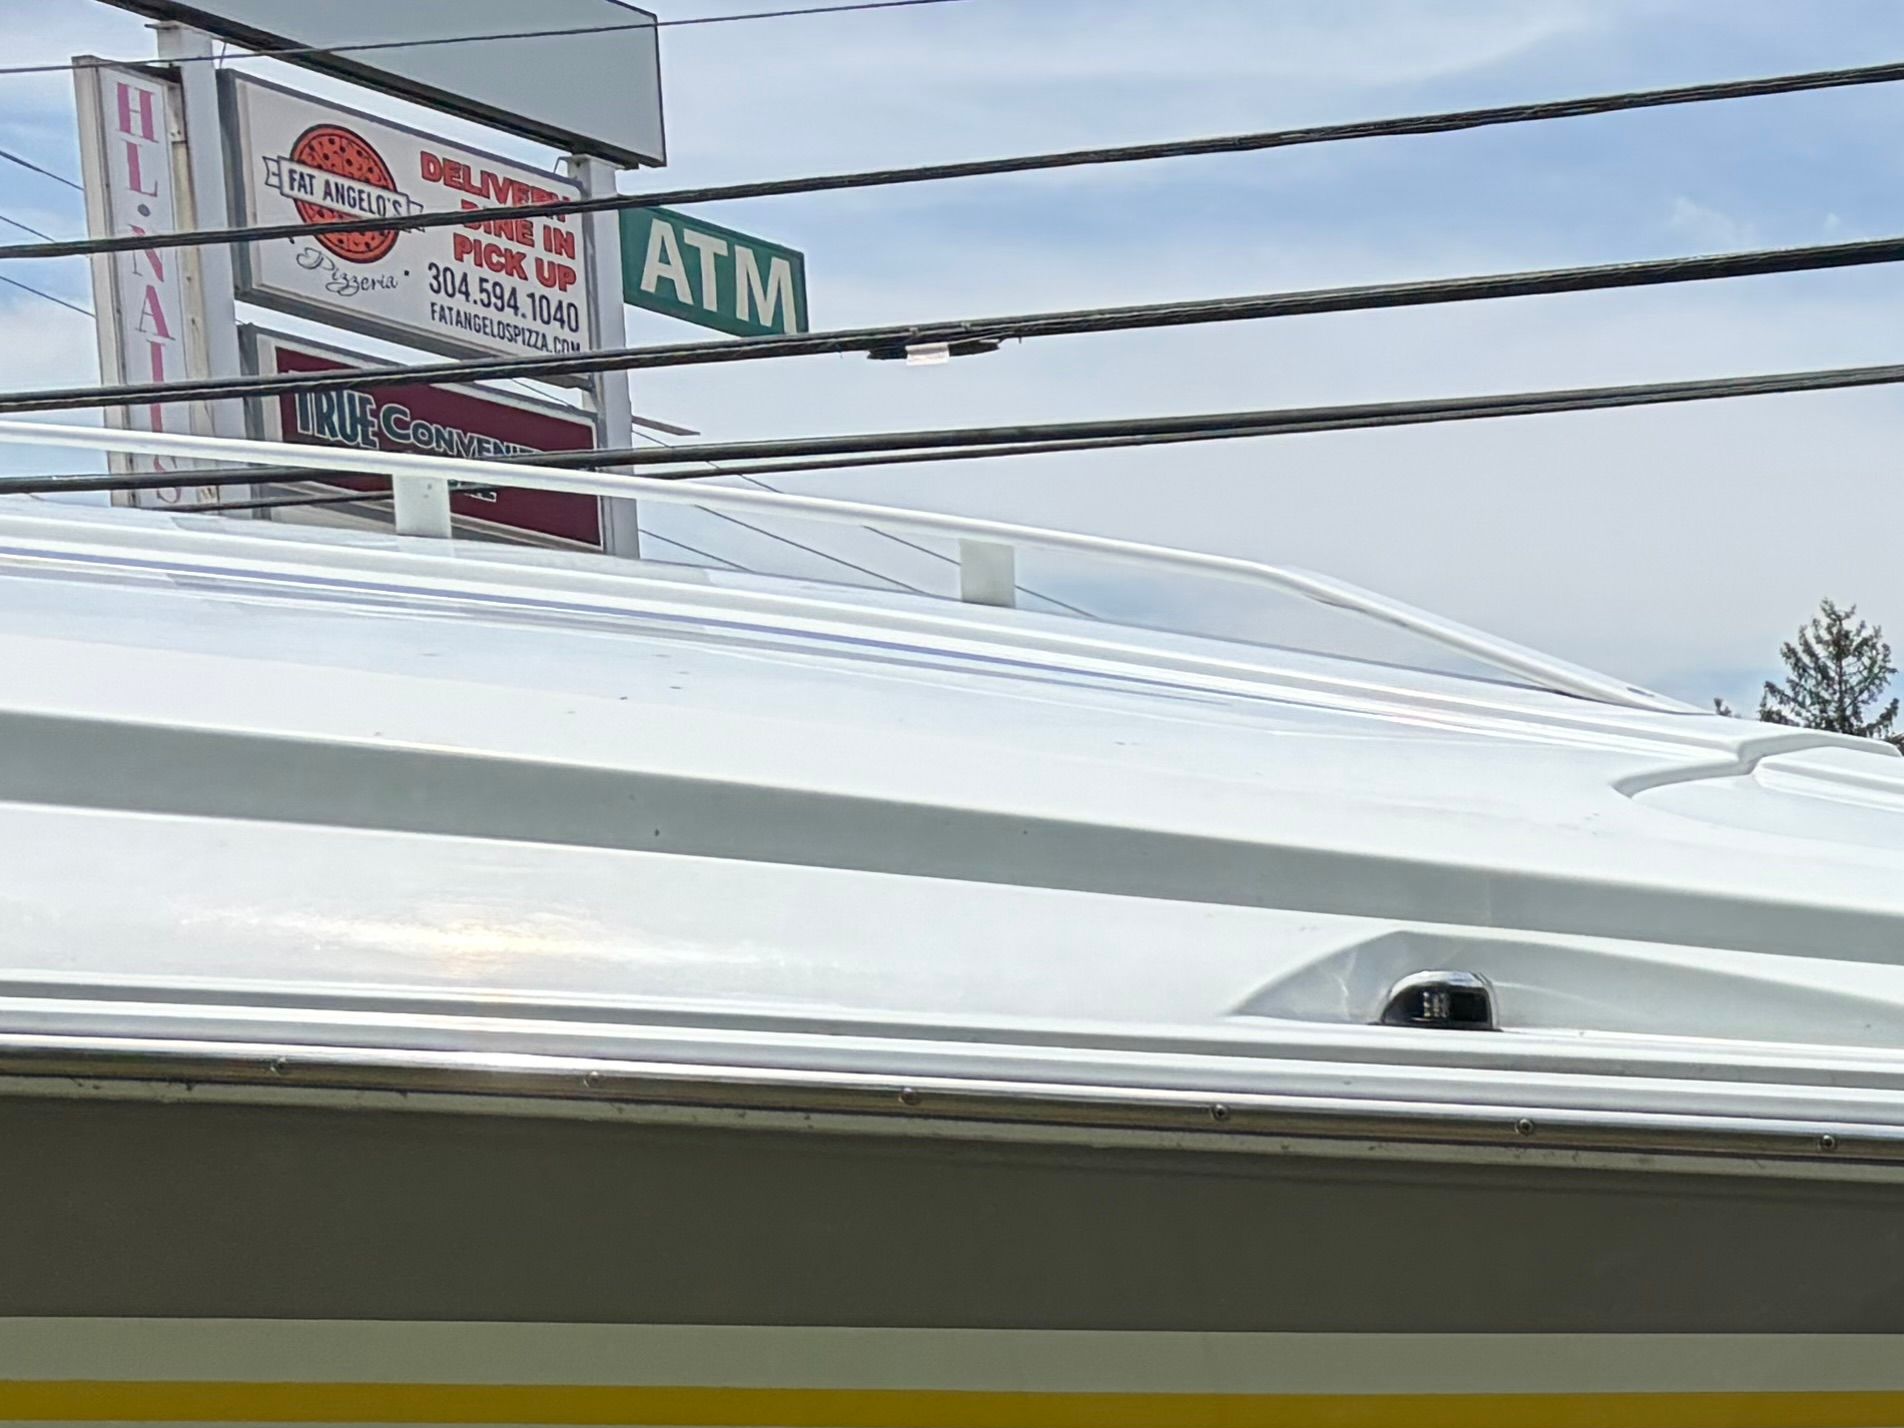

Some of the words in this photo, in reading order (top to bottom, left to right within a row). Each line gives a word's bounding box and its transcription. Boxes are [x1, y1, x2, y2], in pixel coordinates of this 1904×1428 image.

[288, 168, 316, 197] FAT
[322, 179, 403, 218] ANGELO'S
[453, 232, 529, 282] PICK
[534, 256, 578, 293] UP
[543, 224, 577, 261] IN
[296, 247, 399, 297] Pizzeria
[428, 262, 580, 333] 304.594.1040
[640, 218, 797, 335] ATM
[430, 302, 581, 353] FATANGELOSPIZZA.COM
[295, 389, 379, 450] TRUE
